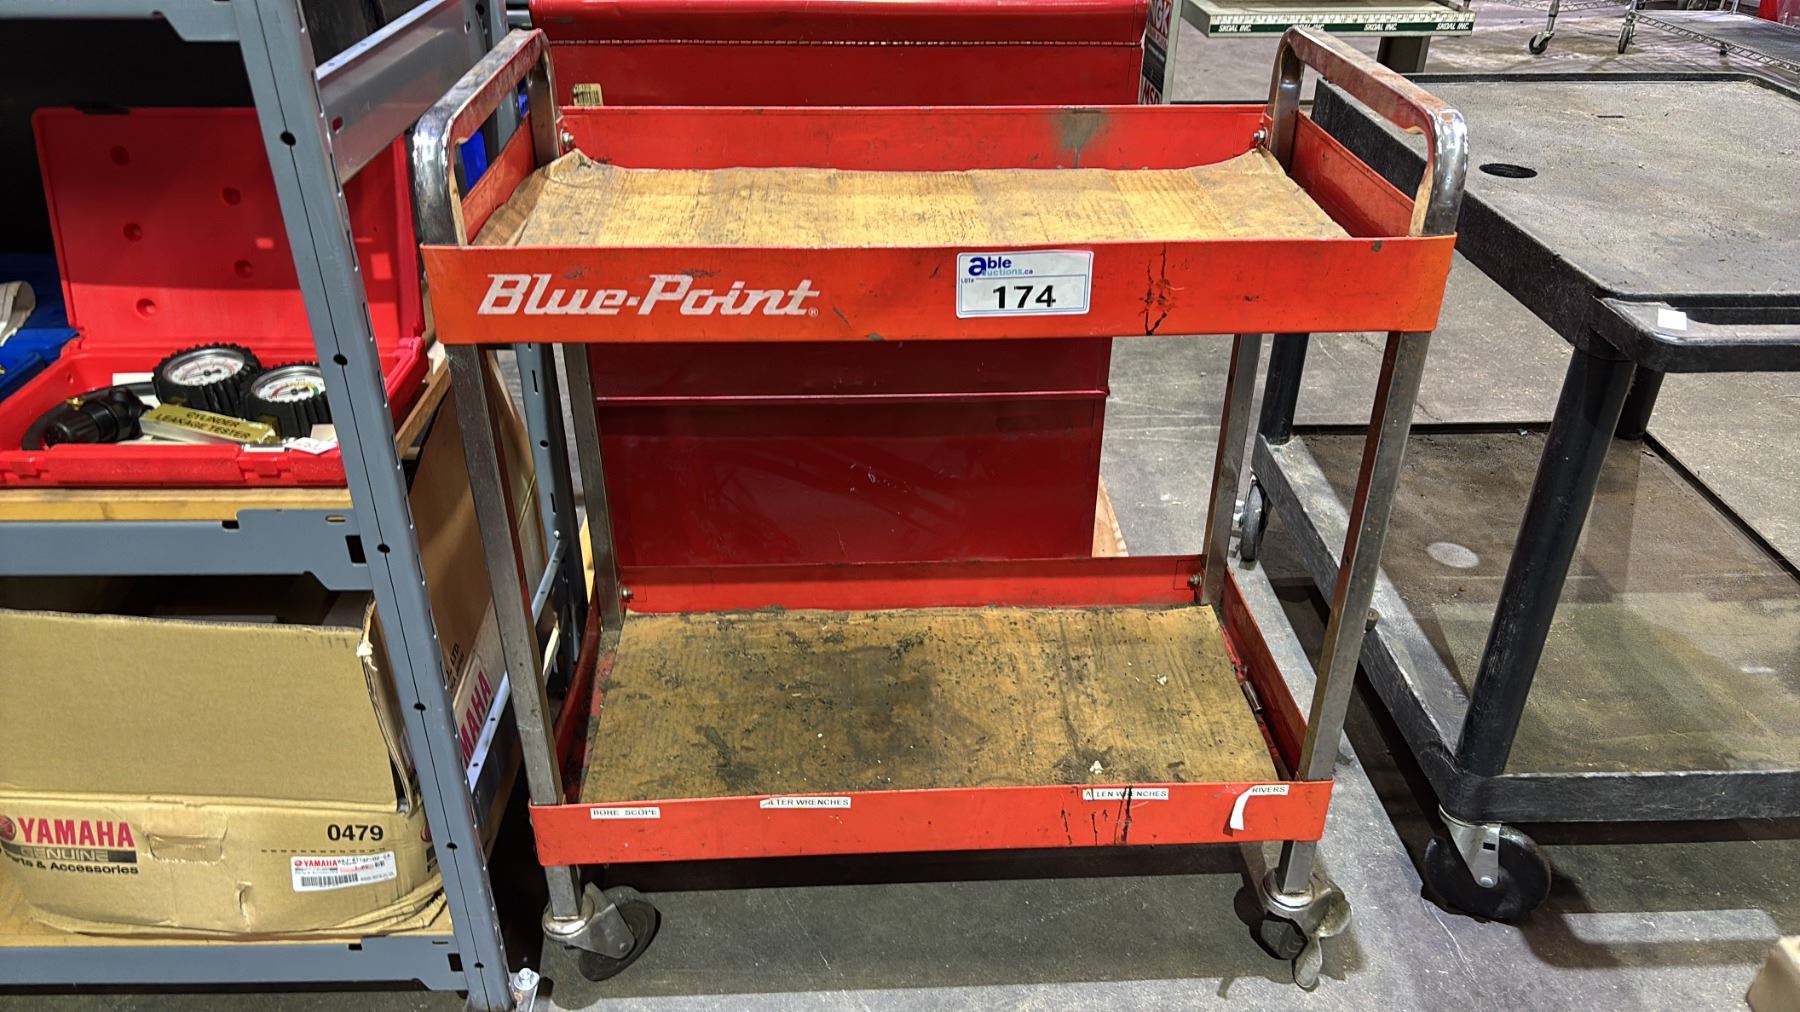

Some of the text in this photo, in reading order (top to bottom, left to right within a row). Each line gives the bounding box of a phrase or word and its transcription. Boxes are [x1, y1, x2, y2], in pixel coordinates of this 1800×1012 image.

[993, 285, 1057, 309] 174
[156, 413, 252, 439] LEAKAGE TESTER
[186, 411, 241, 428] CYLINDER
[796, 797, 849, 806] WRENCHES
[17, 816, 135, 848] YAMAHA
[327, 823, 384, 841] 0479
[50, 861, 139, 874] Accessories
[303, 858, 338, 867] YAMAHA
